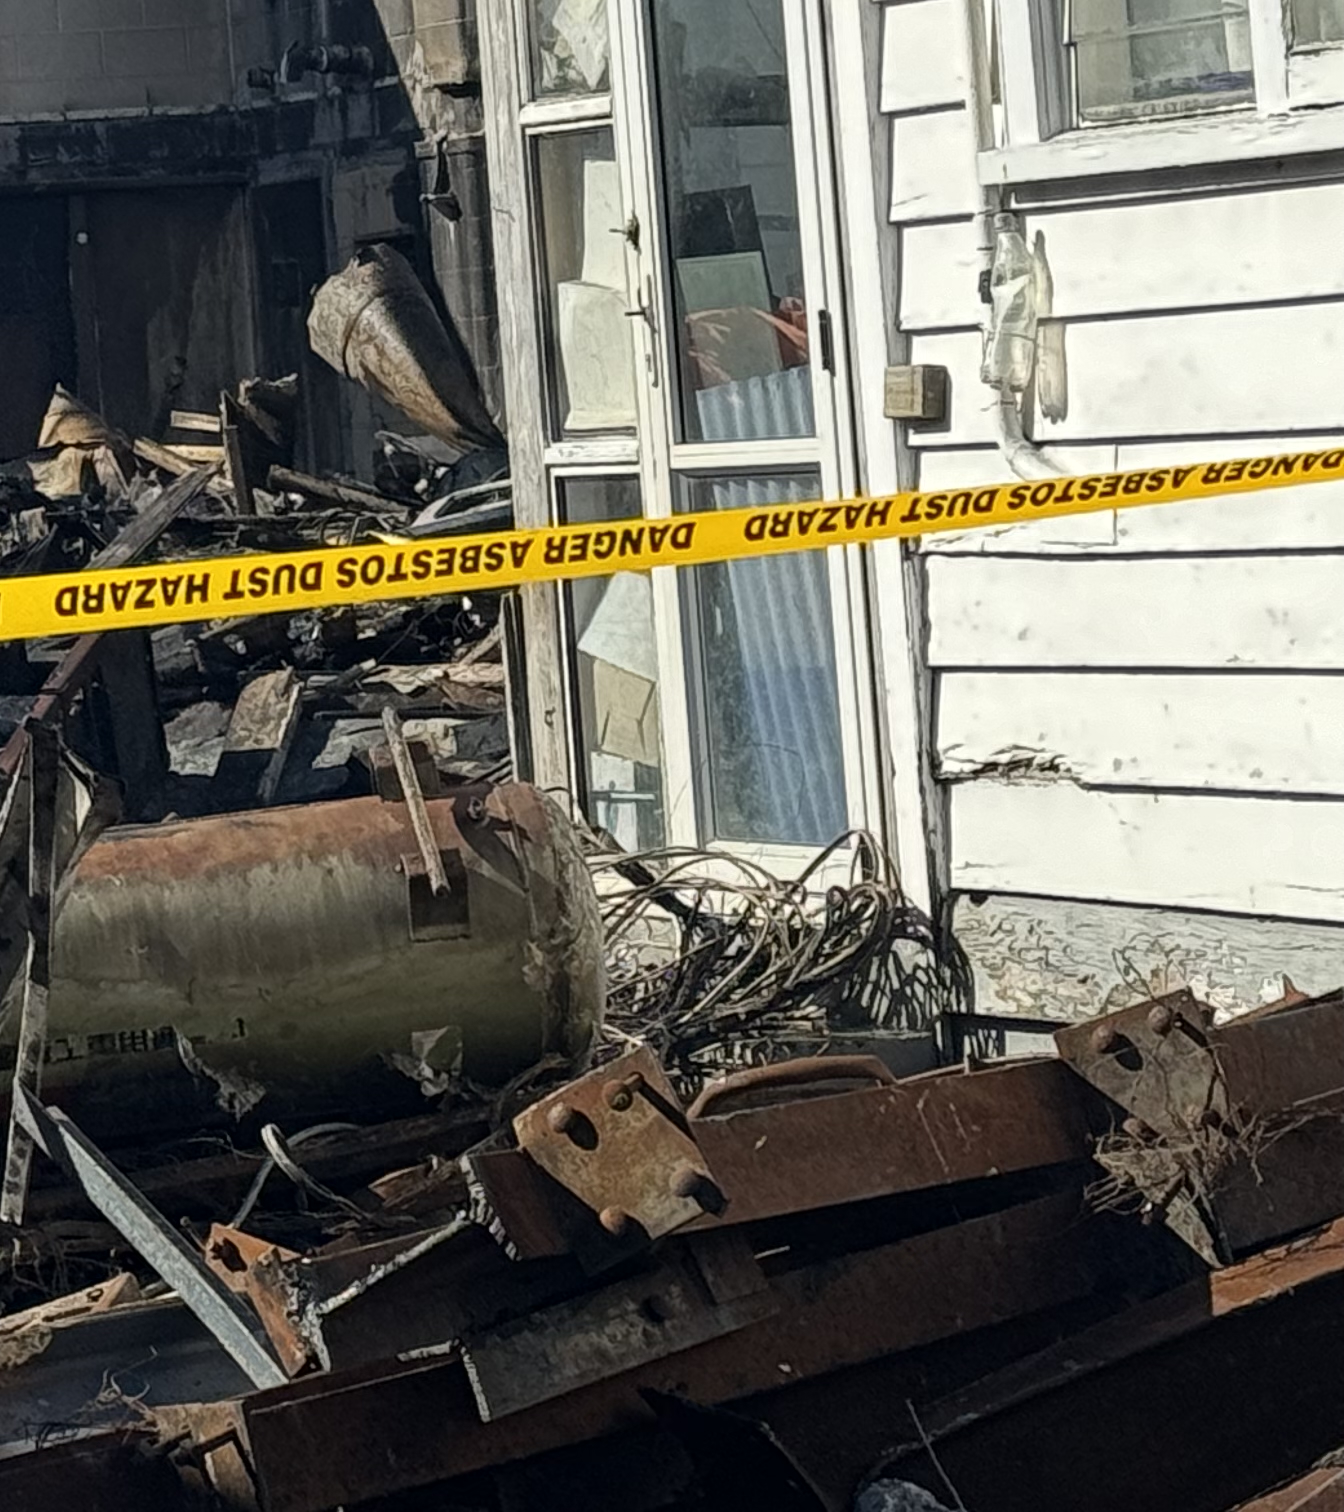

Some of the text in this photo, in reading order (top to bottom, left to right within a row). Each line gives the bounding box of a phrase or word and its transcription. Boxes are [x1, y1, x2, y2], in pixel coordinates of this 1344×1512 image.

[1202, 450, 1344, 484] DANGER
[900, 488, 999, 522] DUST
[1008, 469, 1182, 509] ASBESTOS
[745, 500, 891, 540] HAZARD
[544, 523, 695, 564] DANGER
[223, 562, 323, 600] DUST
[337, 540, 532, 588] ASBESTOS
[55, 573, 210, 616] HAZARD
